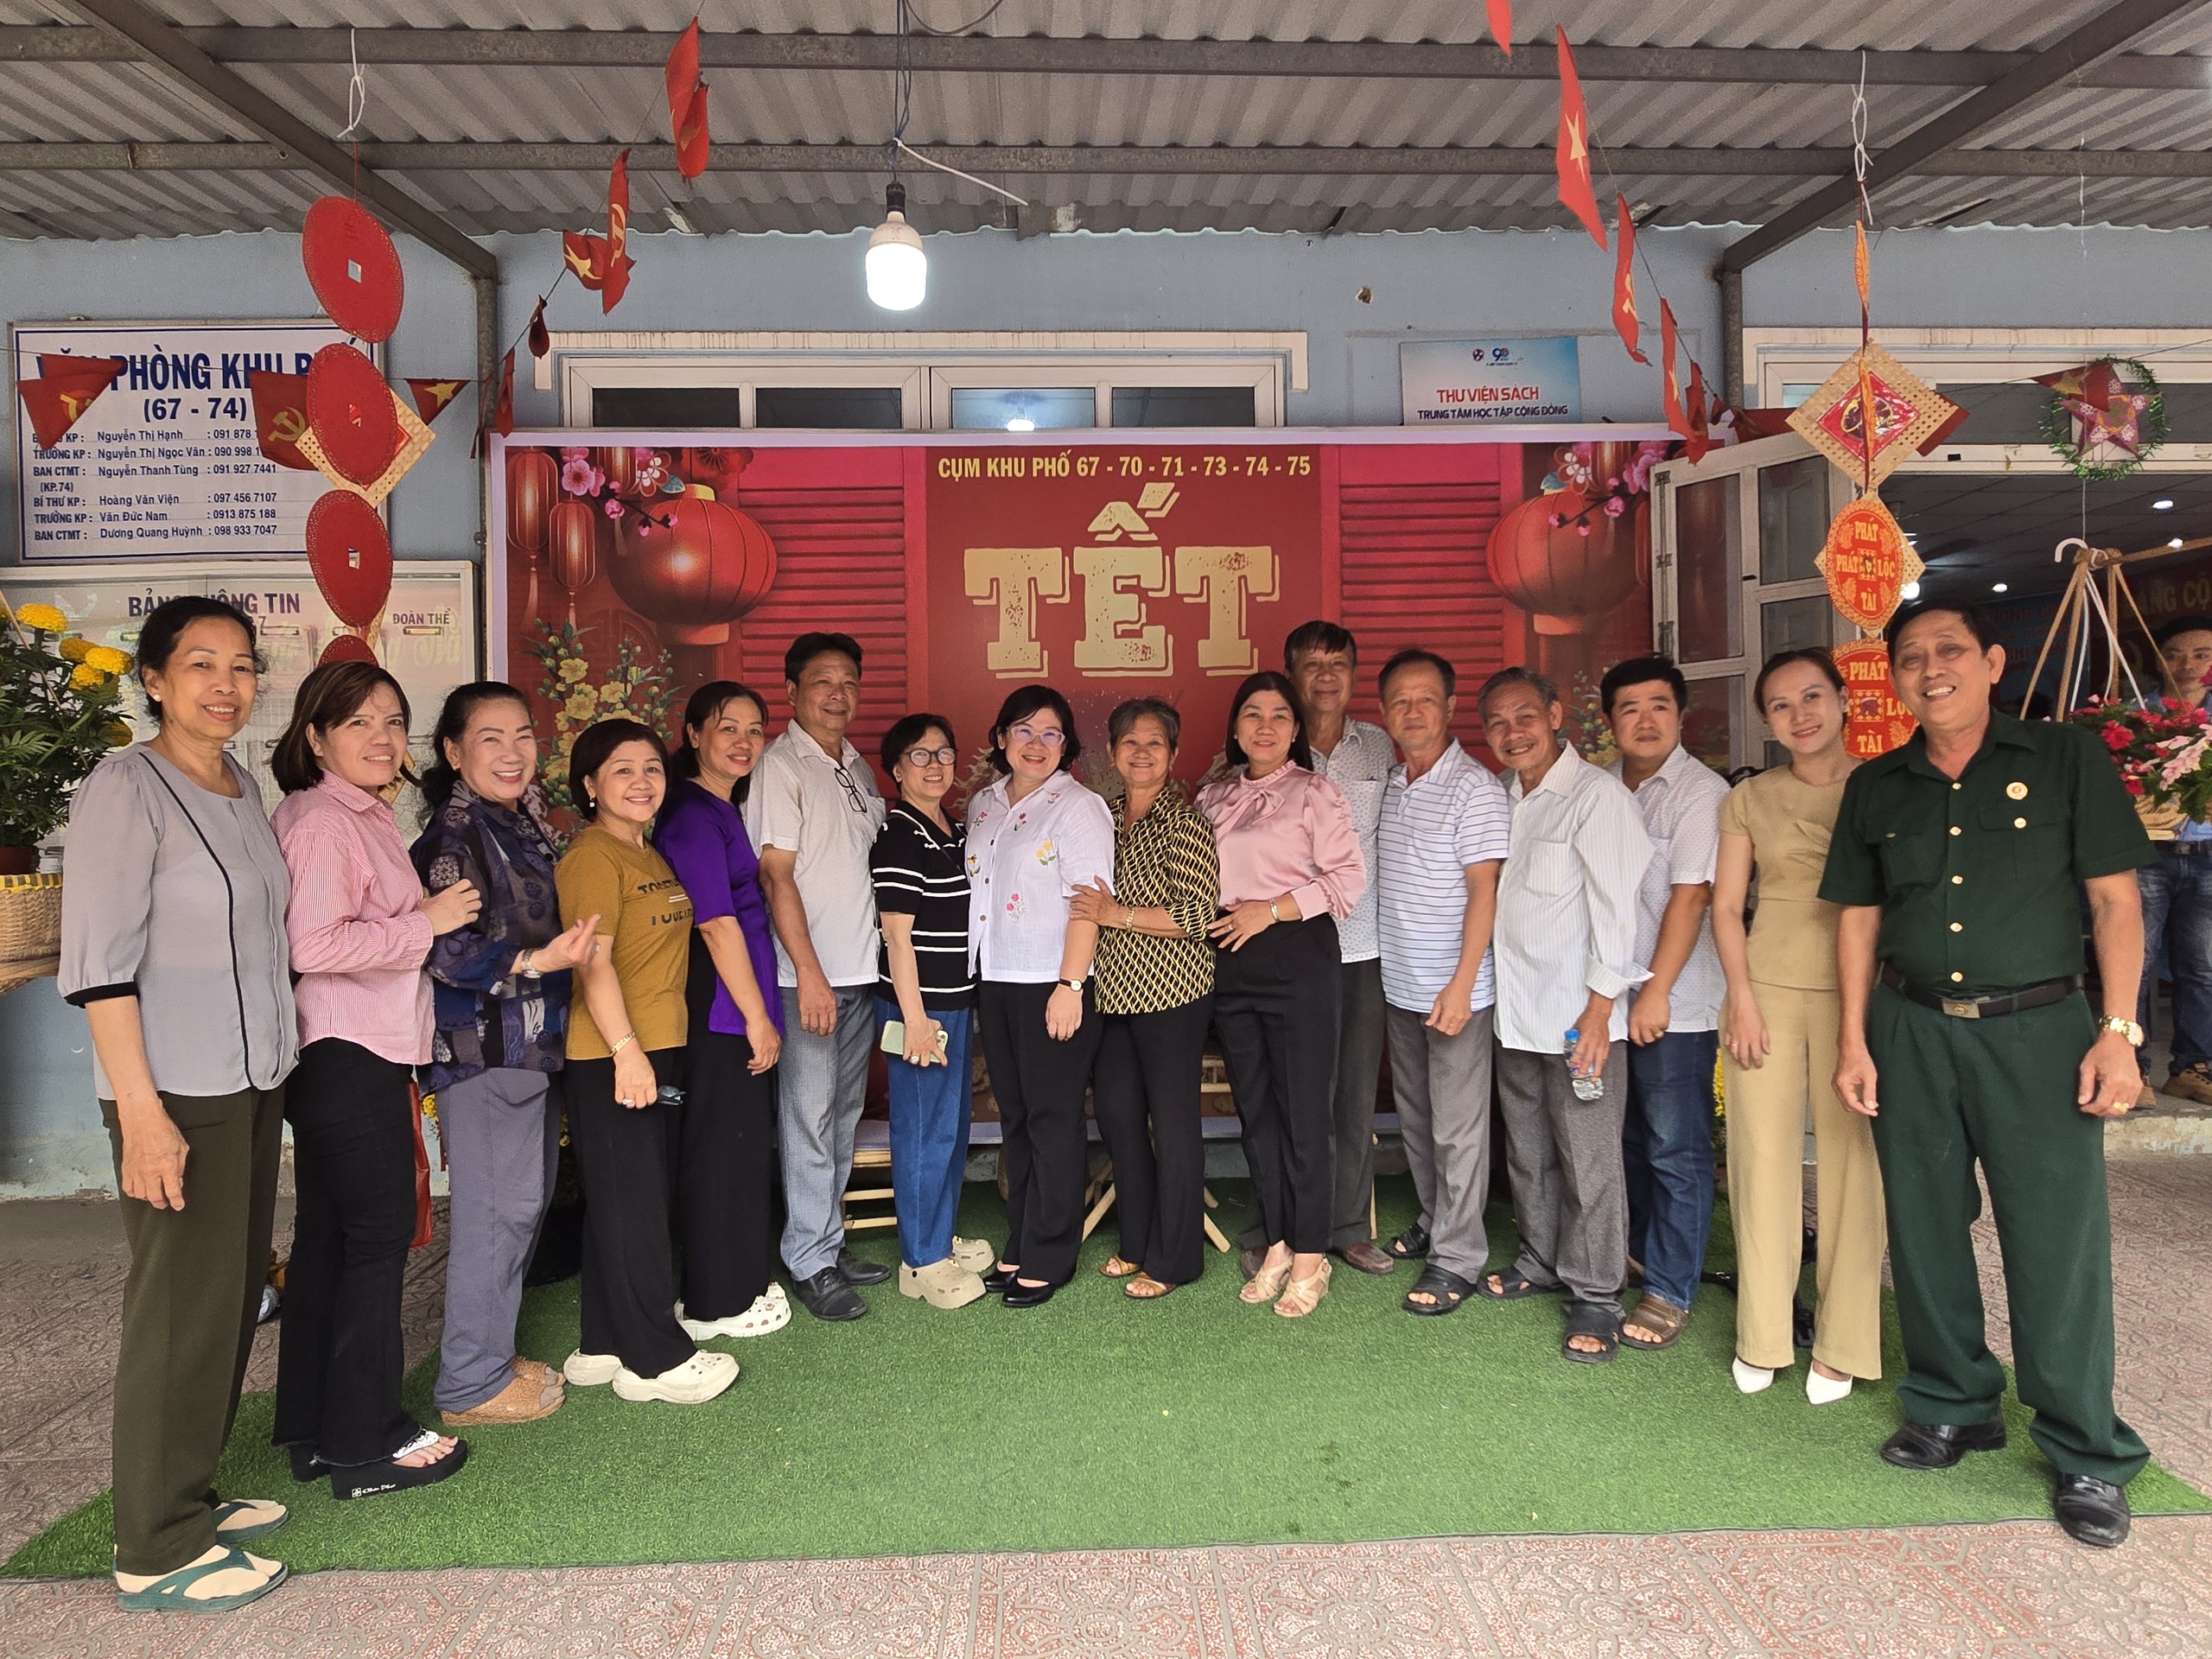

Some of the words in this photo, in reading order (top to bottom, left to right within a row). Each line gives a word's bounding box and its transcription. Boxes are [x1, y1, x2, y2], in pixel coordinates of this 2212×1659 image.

[110, 344, 211, 391] PHÒNG
[1467, 385, 1499, 404] VIỆN
[1501, 384, 1540, 401] SÁCH
[143, 397, 181, 423] (67
[207, 397, 247, 422] 74)
[1417, 409, 1450, 420] TRUNG
[1451, 406, 1472, 419] TÂM
[1473, 408, 1493, 419] HỌC
[1494, 405, 1513, 419] TẬP
[1514, 404, 1541, 416] CỘNG
[1541, 403, 1568, 416] ĐỒNG
[97, 429, 136, 443] Nguyễn
[138, 430, 155, 442] Thị
[157, 429, 183, 442] Hạnh
[213, 429, 230, 439] 091
[233, 429, 251, 439] 878
[98, 446, 137, 461] Nguyễn
[139, 448, 156, 460] Thị
[157, 447, 184, 460] Ngọc
[186, 446, 206, 457] Vân
[214, 447, 232, 456] 090
[234, 446, 252, 456] 998
[33, 467, 53, 477] BAN
[99, 464, 137, 479] Nguyễn
[139, 465, 171, 475] Thanh
[173, 465, 199, 476] Tùng
[213, 464, 230, 474] 091
[233, 464, 251, 474] 927
[254, 464, 276, 474] 7441
[938, 457, 981, 482] CỤM
[987, 457, 1026, 477] KHU
[1032, 448, 1072, 477] PHỐ
[1077, 456, 1100, 477] 67
[1119, 456, 1142, 476] 70
[1161, 456, 1184, 476] 71
[1203, 456, 1227, 476] 73
[1245, 456, 1269, 476] 74
[1287, 455, 1311, 476] 75
[33, 494, 44, 507] BÍ
[46, 495, 65, 507] THƯ
[99, 494, 132, 507] Hoàng
[135, 494, 155, 505] Văn
[157, 493, 180, 505] Viện
[213, 493, 231, 503] 097
[233, 493, 251, 502] 456
[254, 493, 277, 502] 7107
[99, 512, 119, 522] Văn
[122, 511, 143, 521] Đức
[145, 511, 168, 521] Nam
[213, 509, 236, 519] 0913
[238, 509, 256, 518] 875
[259, 509, 276, 518] 188
[35, 531, 53, 541] BAN
[100, 528, 133, 540] Dương
[136, 527, 169, 539] Quang
[171, 525, 203, 538] Huỳnh
[214, 525, 232, 535] 098
[233, 525, 251, 535] 933
[254, 524, 277, 535] 7047
[1854, 517, 1878, 542] PHÁT
[1836, 550, 1859, 573] PHÁT
[1877, 556, 1896, 581] LỘC
[963, 482, 1280, 679] TẾT
[264, 593, 301, 613] TIN
[1860, 587, 1877, 612] TÀI
[392, 610, 424, 625] ĐOÀN
[428, 608, 451, 625] THỂ
[1849, 654, 1888, 681] PHÁT
[1857, 729, 1883, 753] TÀI
